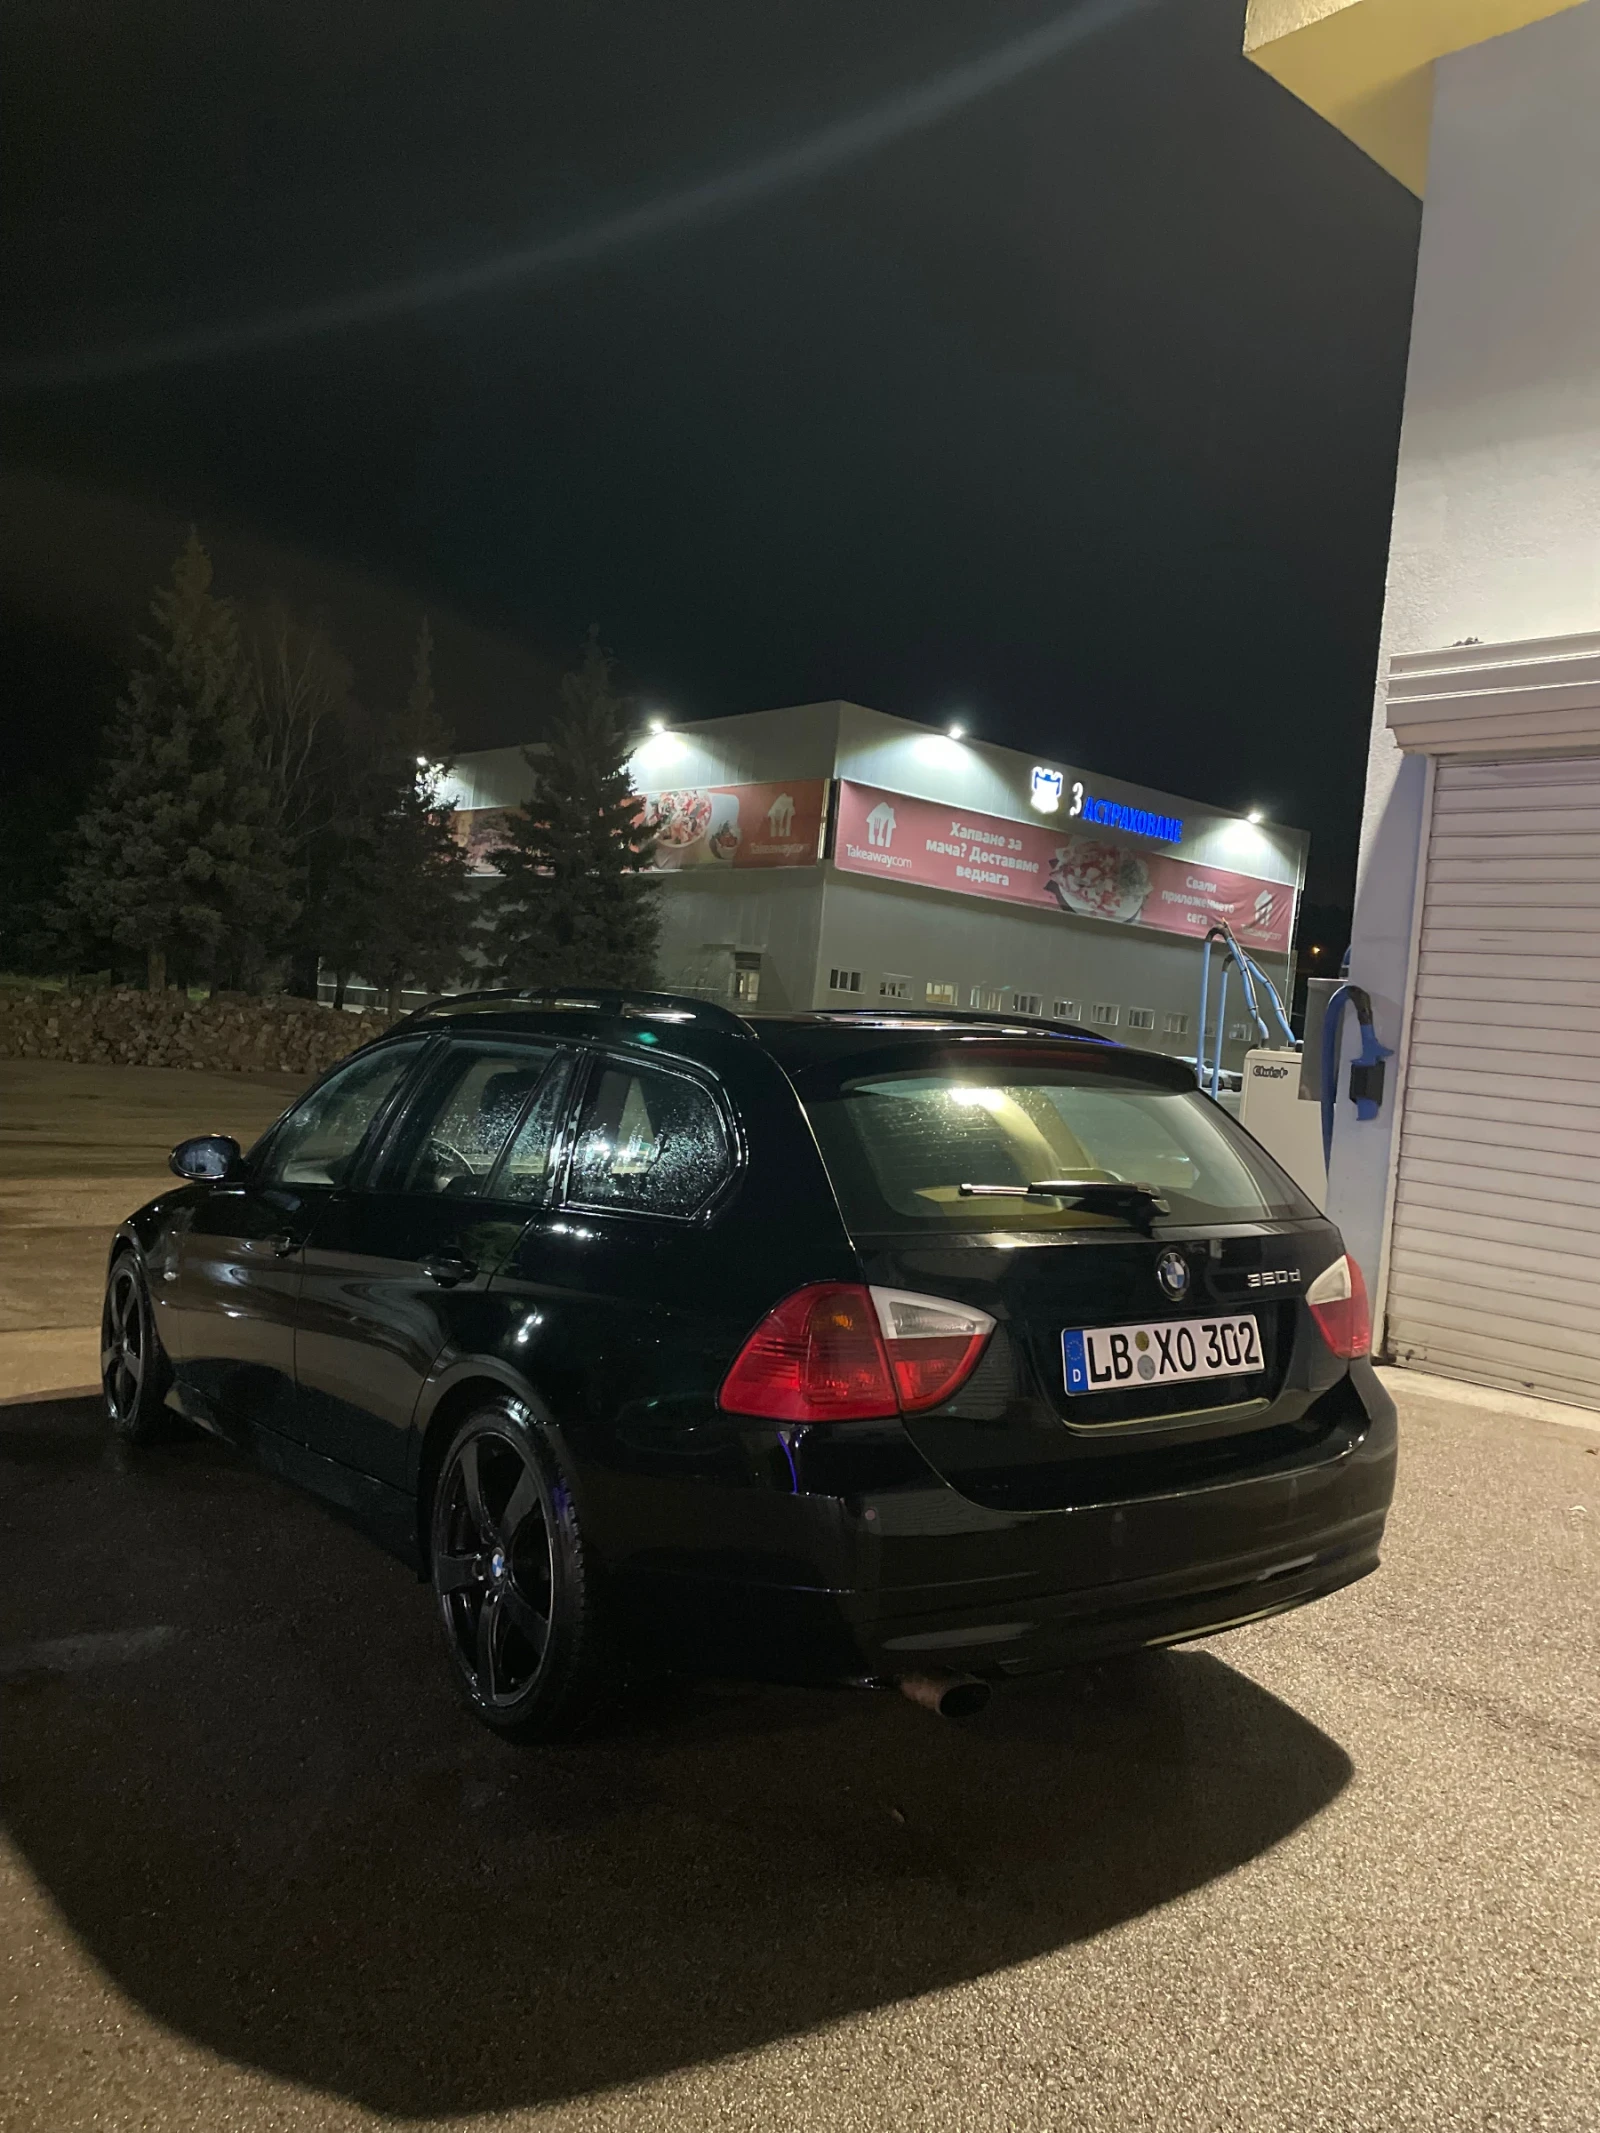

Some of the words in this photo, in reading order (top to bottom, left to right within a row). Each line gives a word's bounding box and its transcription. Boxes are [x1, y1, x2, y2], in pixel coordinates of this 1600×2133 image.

[950, 822, 1005, 847] Хапване
[1008, 837, 1023, 851] за
[926, 839, 966, 859] мача?
[969, 846, 1040, 874] Доставяме
[956, 865, 1009, 886] веднага
[1186, 876, 1217, 893] Свали
[1186, 912, 1208, 925] сега
[1247, 1268, 1301, 1288] 320d
[1087, 1333, 1133, 1384] LB
[1154, 1326, 1197, 1375] XO
[1201, 1321, 1260, 1369] 302
[1073, 1369, 1082, 1383] D
